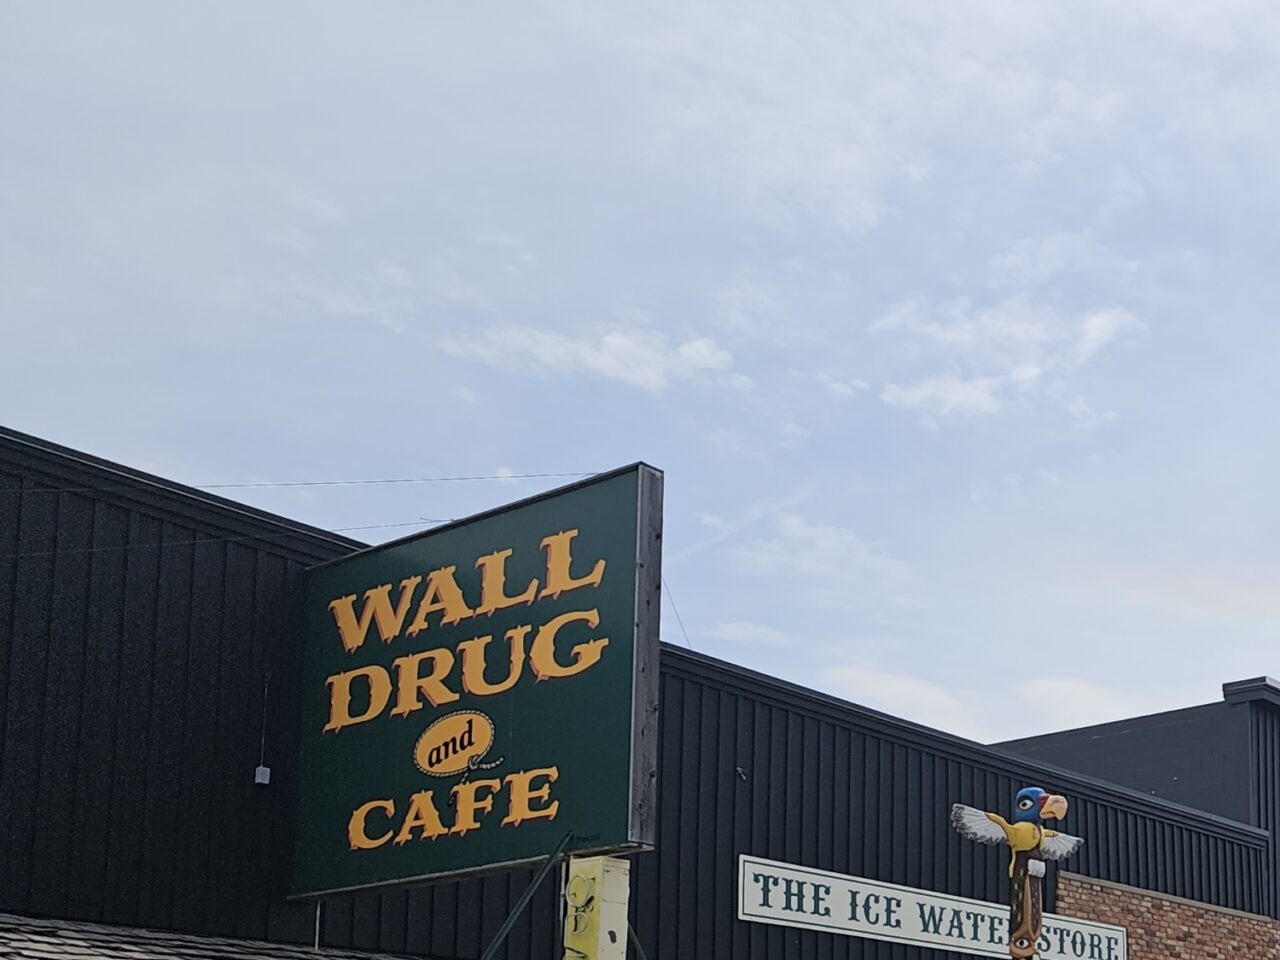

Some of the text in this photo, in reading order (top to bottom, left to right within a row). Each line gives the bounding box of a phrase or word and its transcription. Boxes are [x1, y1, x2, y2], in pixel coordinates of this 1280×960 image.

[327, 529, 606, 653] WALL
[322, 609, 609, 733] DRUG
[427, 719, 475, 768] and
[347, 766, 560, 851] CAFE
[753, 872, 831, 918] THE
[848, 890, 902, 929] ICE
